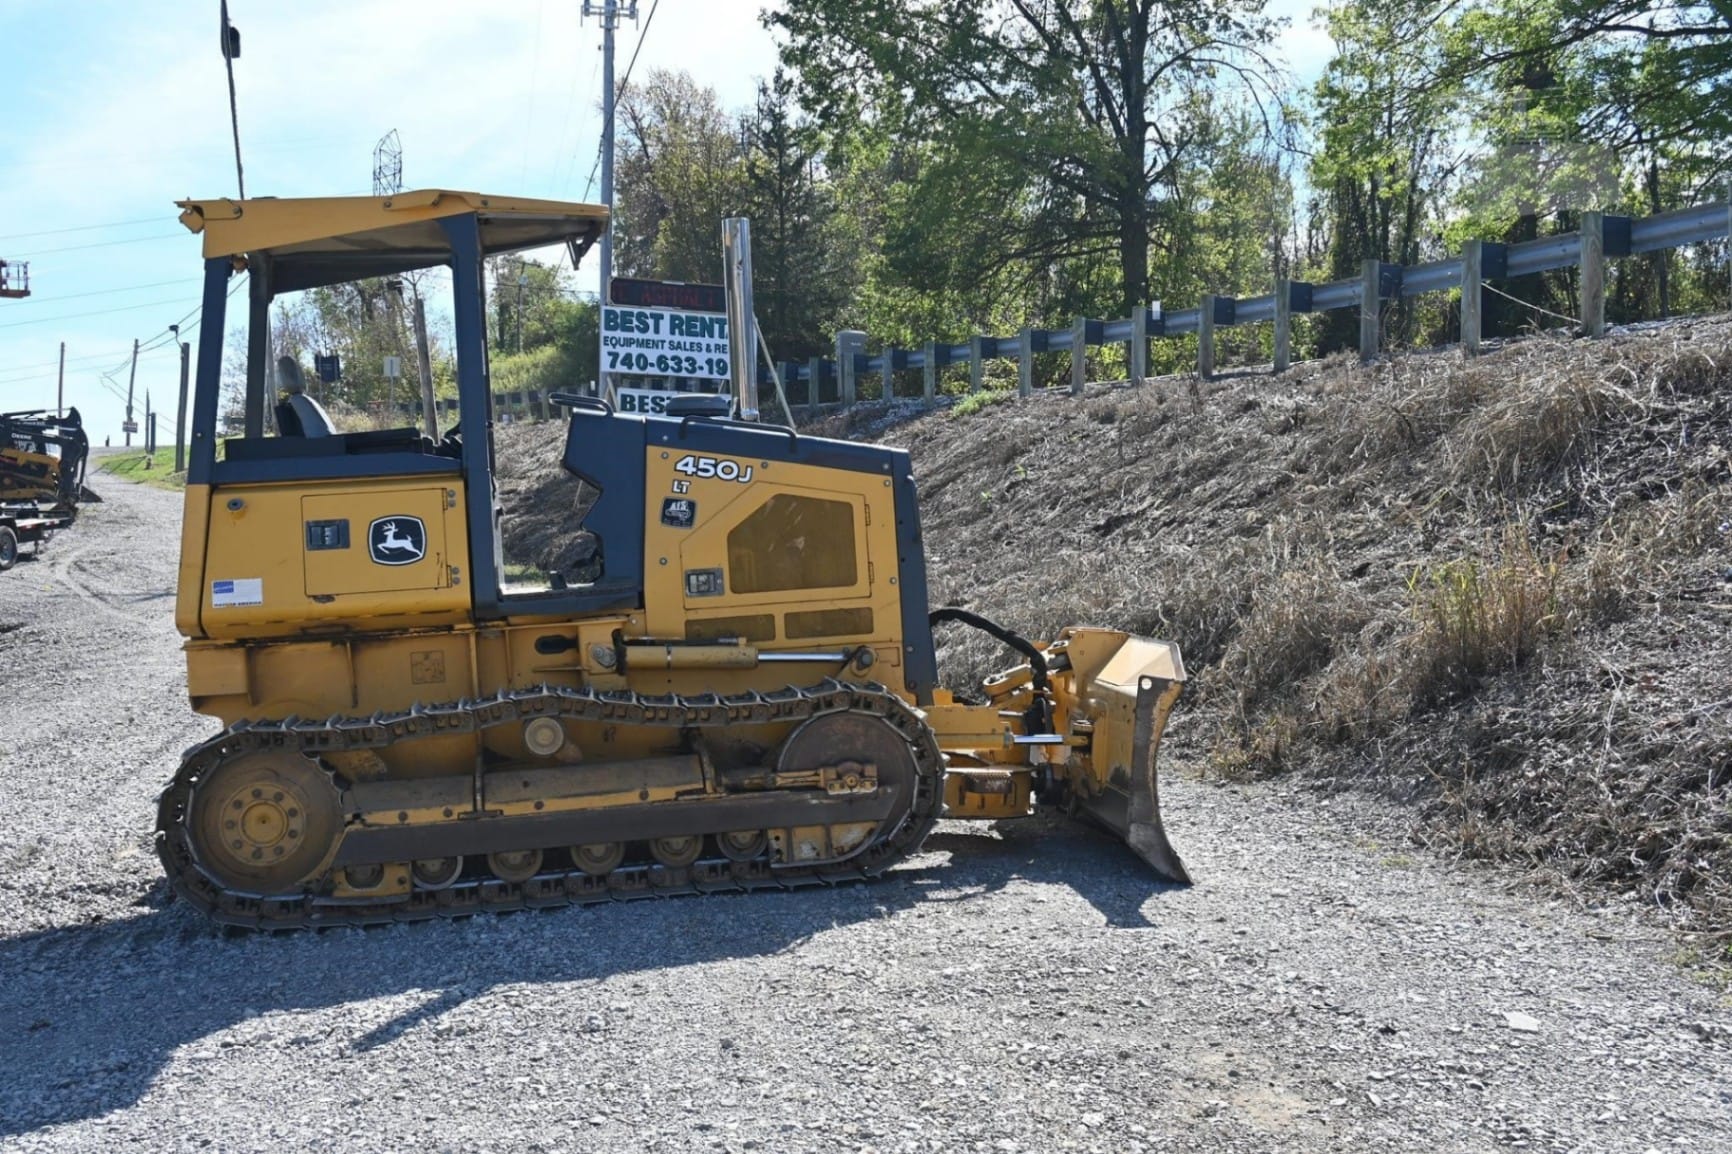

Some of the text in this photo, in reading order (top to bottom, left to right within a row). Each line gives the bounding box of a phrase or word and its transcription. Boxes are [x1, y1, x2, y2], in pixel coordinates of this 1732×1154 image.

[604, 309, 729, 340] BEST RENT
[603, 336, 666, 350] EQUIPMENT
[668, 340, 703, 353] SALES
[705, 344, 713, 353] &
[607, 352, 729, 376] 740-633-19
[620, 393, 672, 414] BES
[675, 454, 753, 483] 450J
[672, 479, 691, 494] LT
